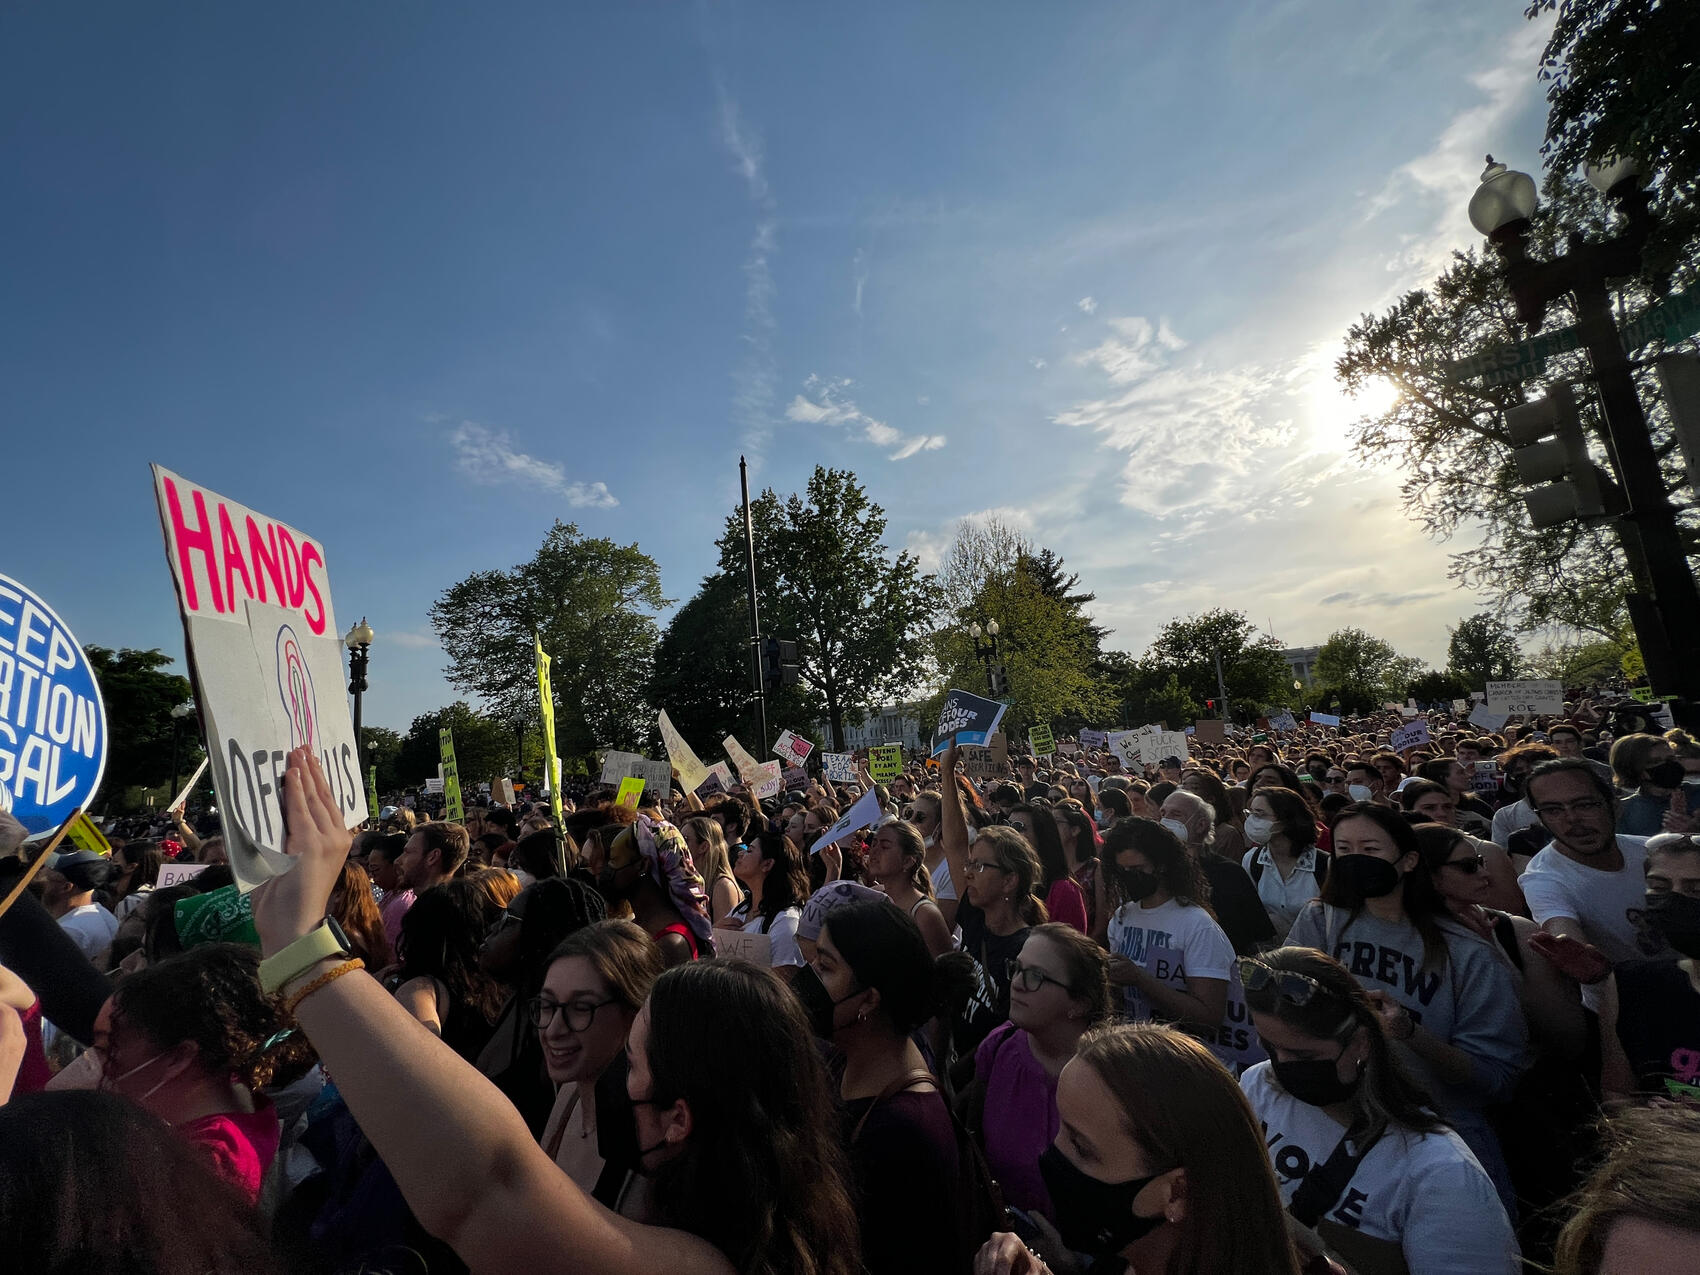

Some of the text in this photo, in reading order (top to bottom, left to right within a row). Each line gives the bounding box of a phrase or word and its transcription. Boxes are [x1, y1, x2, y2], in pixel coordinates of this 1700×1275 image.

[164, 476, 326, 636] HANDS
[942, 697, 960, 711] ANS
[1508, 704, 1537, 712] ROE
[951, 707, 979, 720] OUR
[1150, 734, 1177, 747] FUCK
[1404, 729, 1423, 739] OUR
[969, 750, 993, 762] SAFE
[324, 742, 355, 822] US
[1333, 941, 1440, 1006] CREW
[1261, 1120, 1368, 1229] VOE
